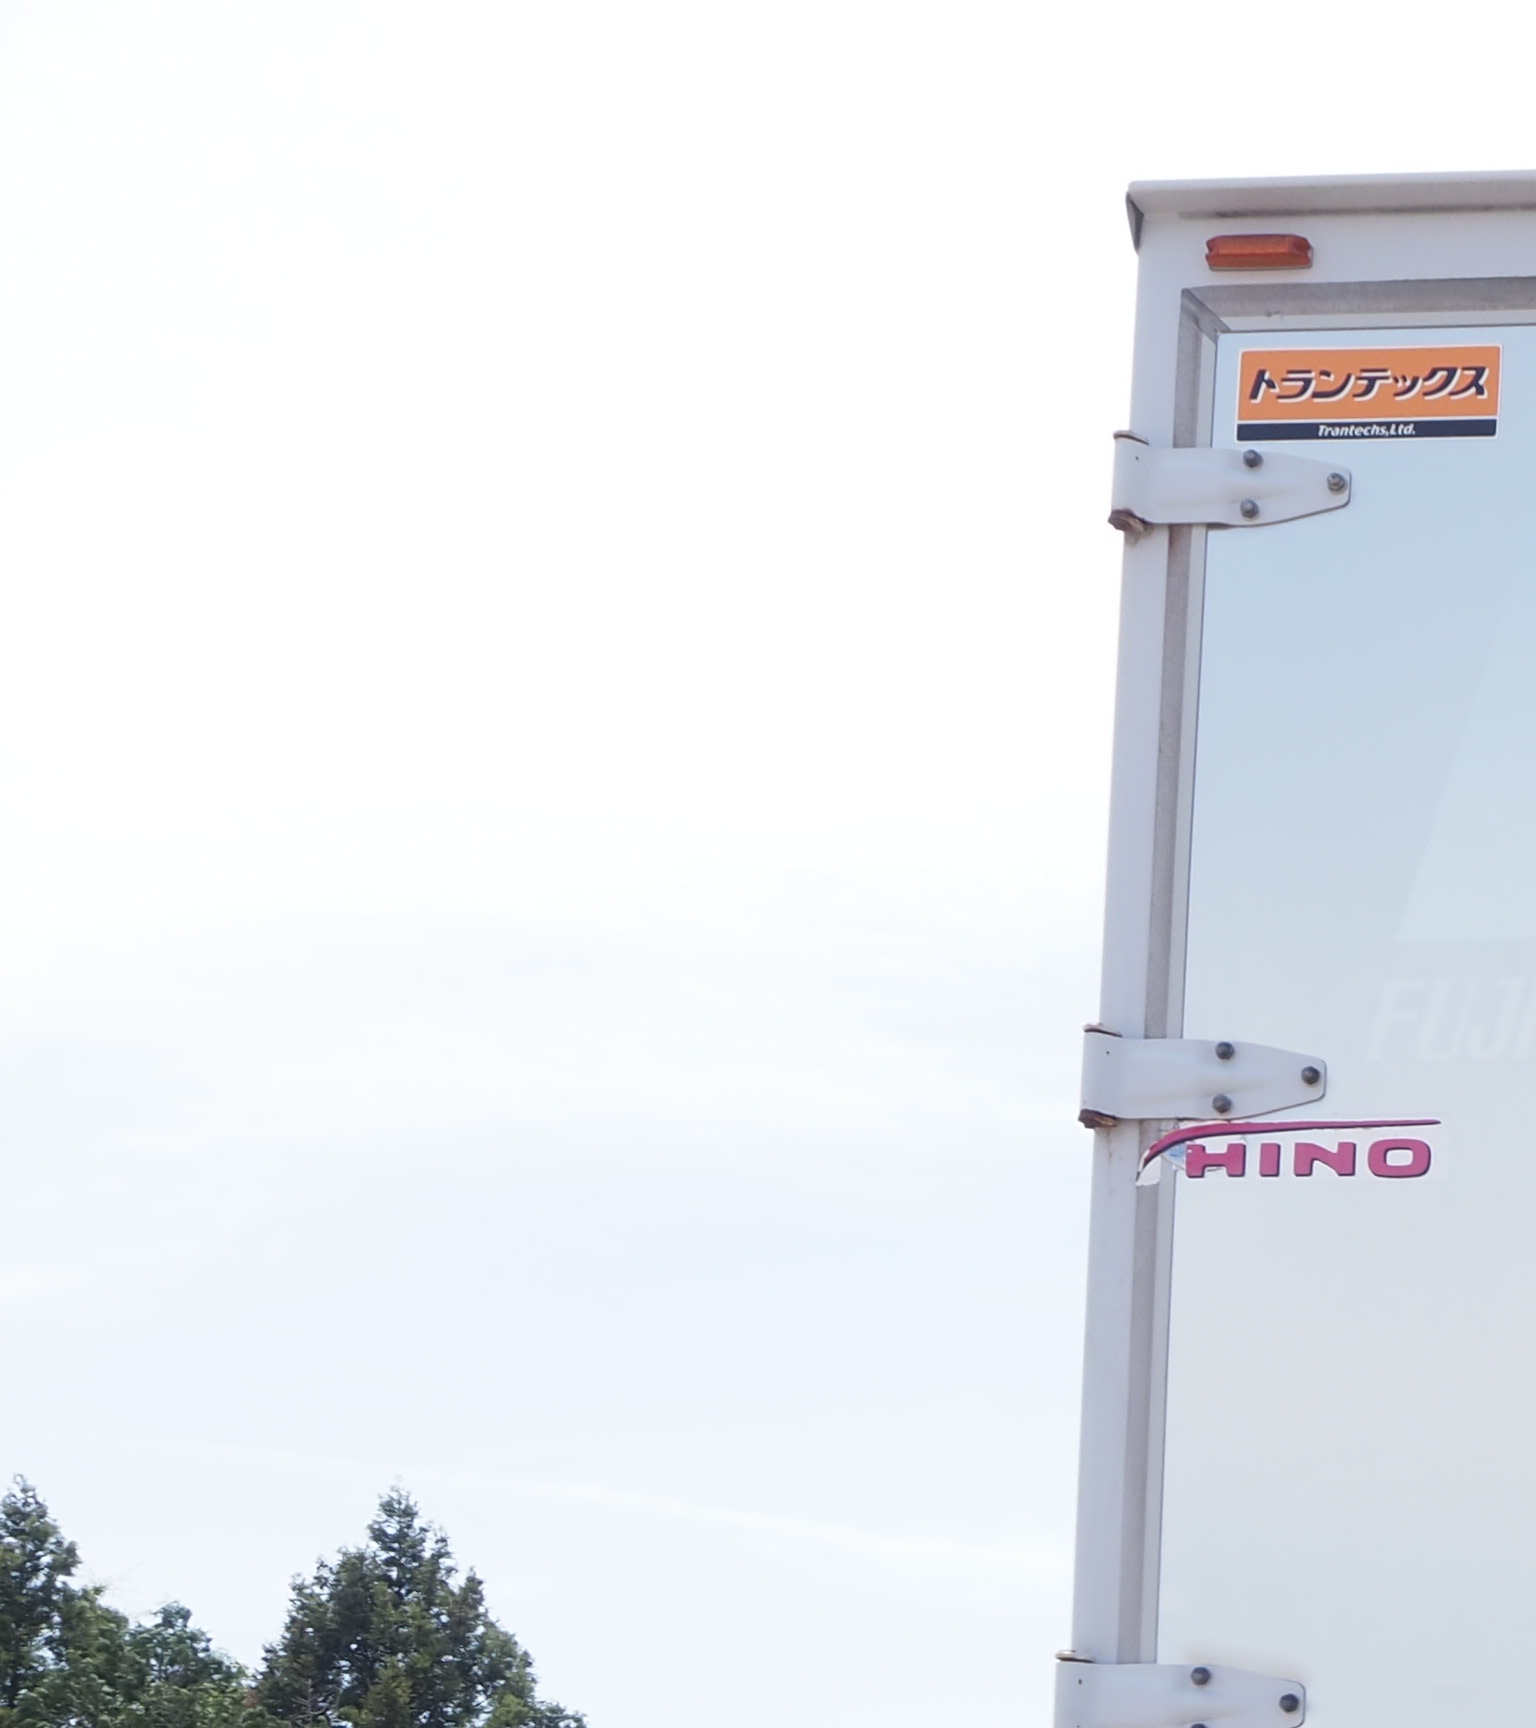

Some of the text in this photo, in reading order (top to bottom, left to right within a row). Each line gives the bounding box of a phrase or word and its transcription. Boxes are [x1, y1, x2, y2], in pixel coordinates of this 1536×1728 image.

[1249, 366, 1490, 404] トランテックス
[1185, 1137, 1432, 1178] HINO
